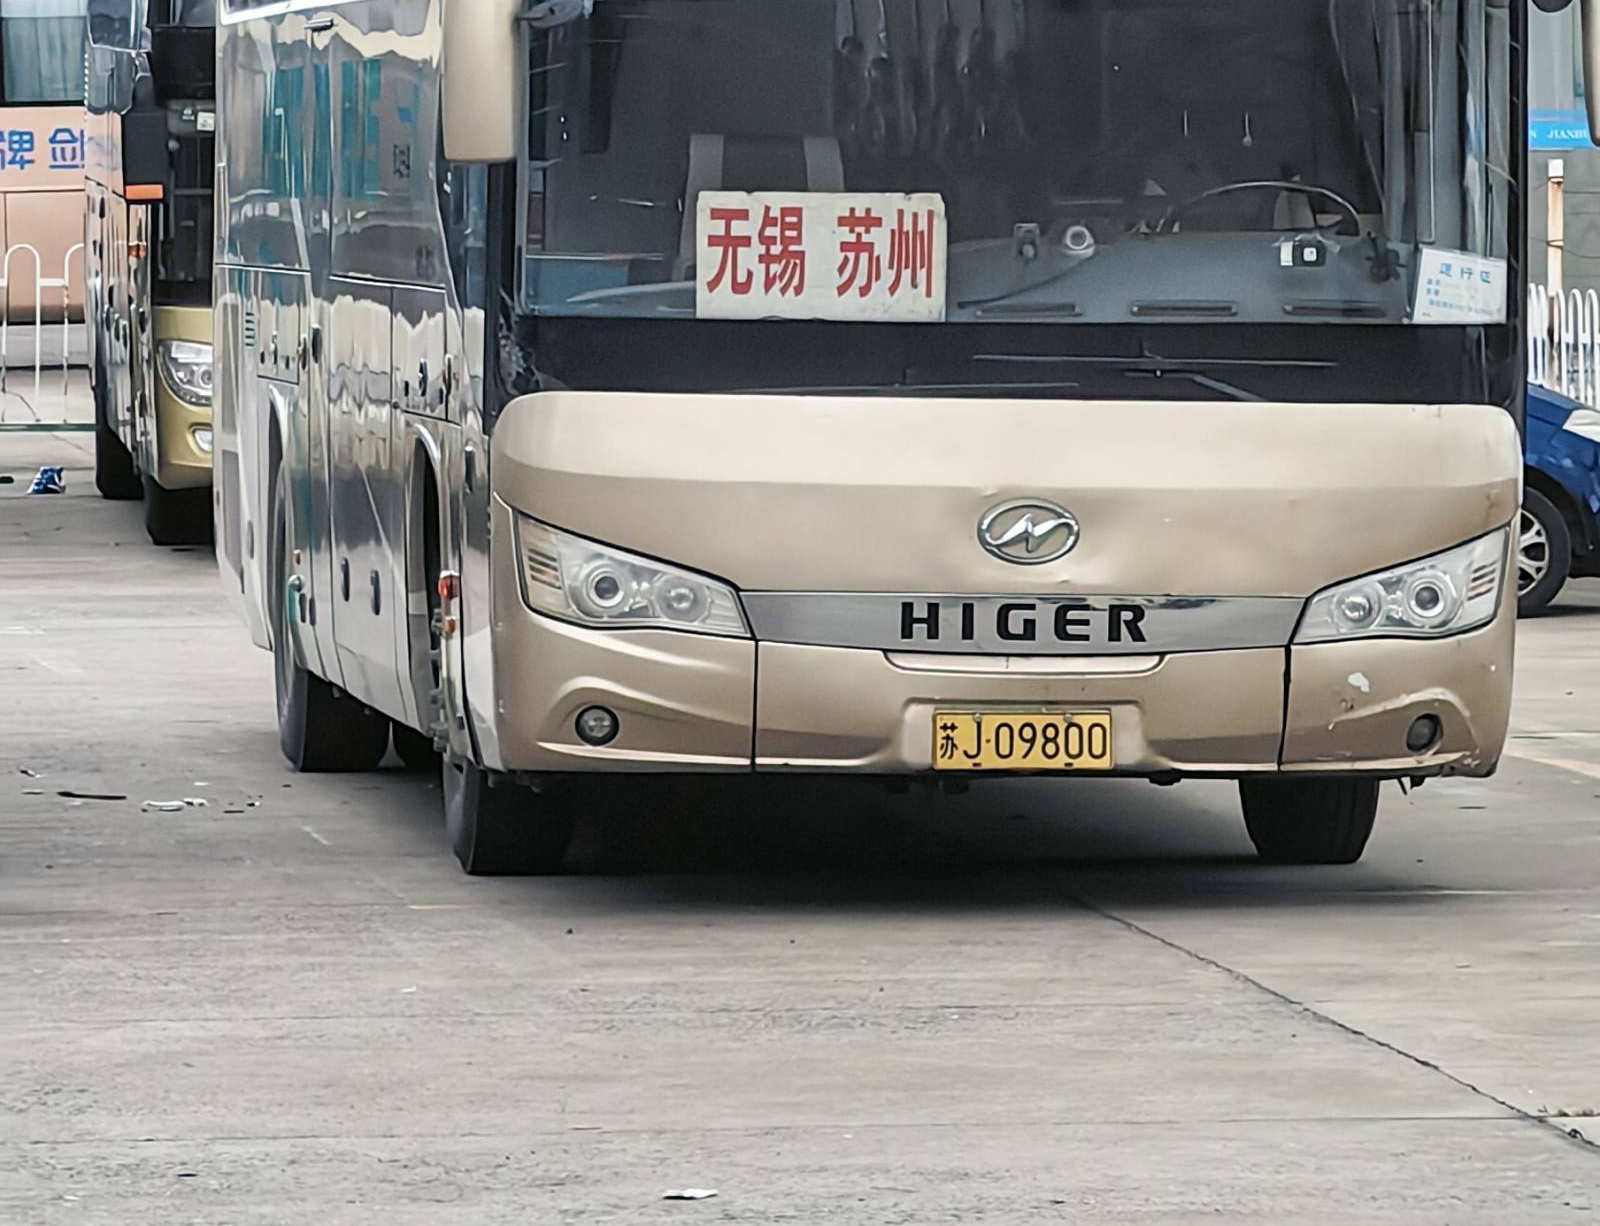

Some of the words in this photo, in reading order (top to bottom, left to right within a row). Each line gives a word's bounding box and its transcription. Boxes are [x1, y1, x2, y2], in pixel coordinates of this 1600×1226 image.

[706, 205, 805, 296] 无锡
[836, 207, 935, 298] 苏州
[900, 601, 1147, 643] HIGER
